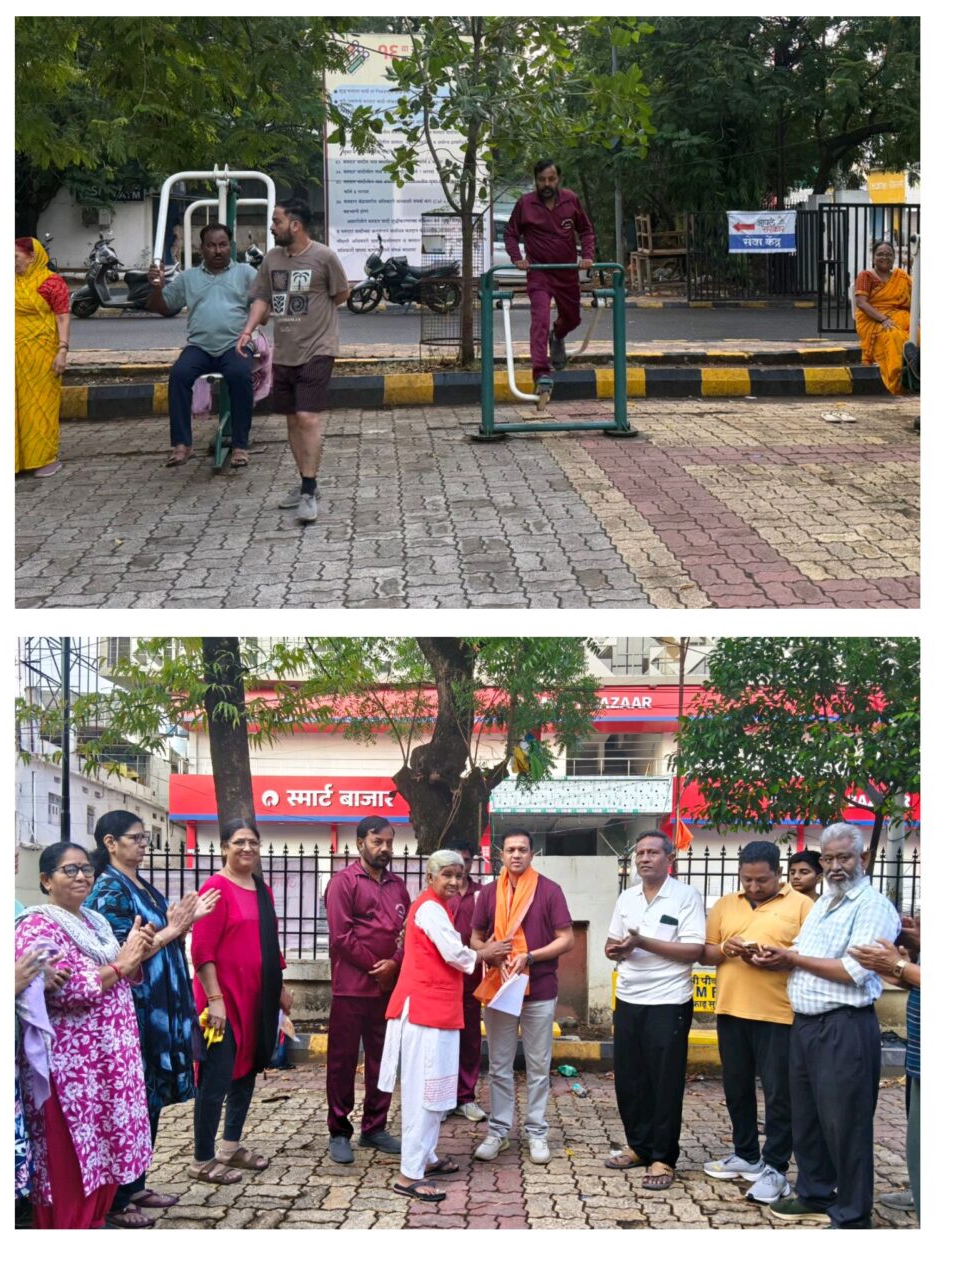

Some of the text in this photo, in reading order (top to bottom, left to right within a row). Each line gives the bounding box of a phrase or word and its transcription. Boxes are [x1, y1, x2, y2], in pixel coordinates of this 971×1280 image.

[597, 696, 652, 709] AZAAR
[286, 783, 396, 807] स्मार्ट बाजार
